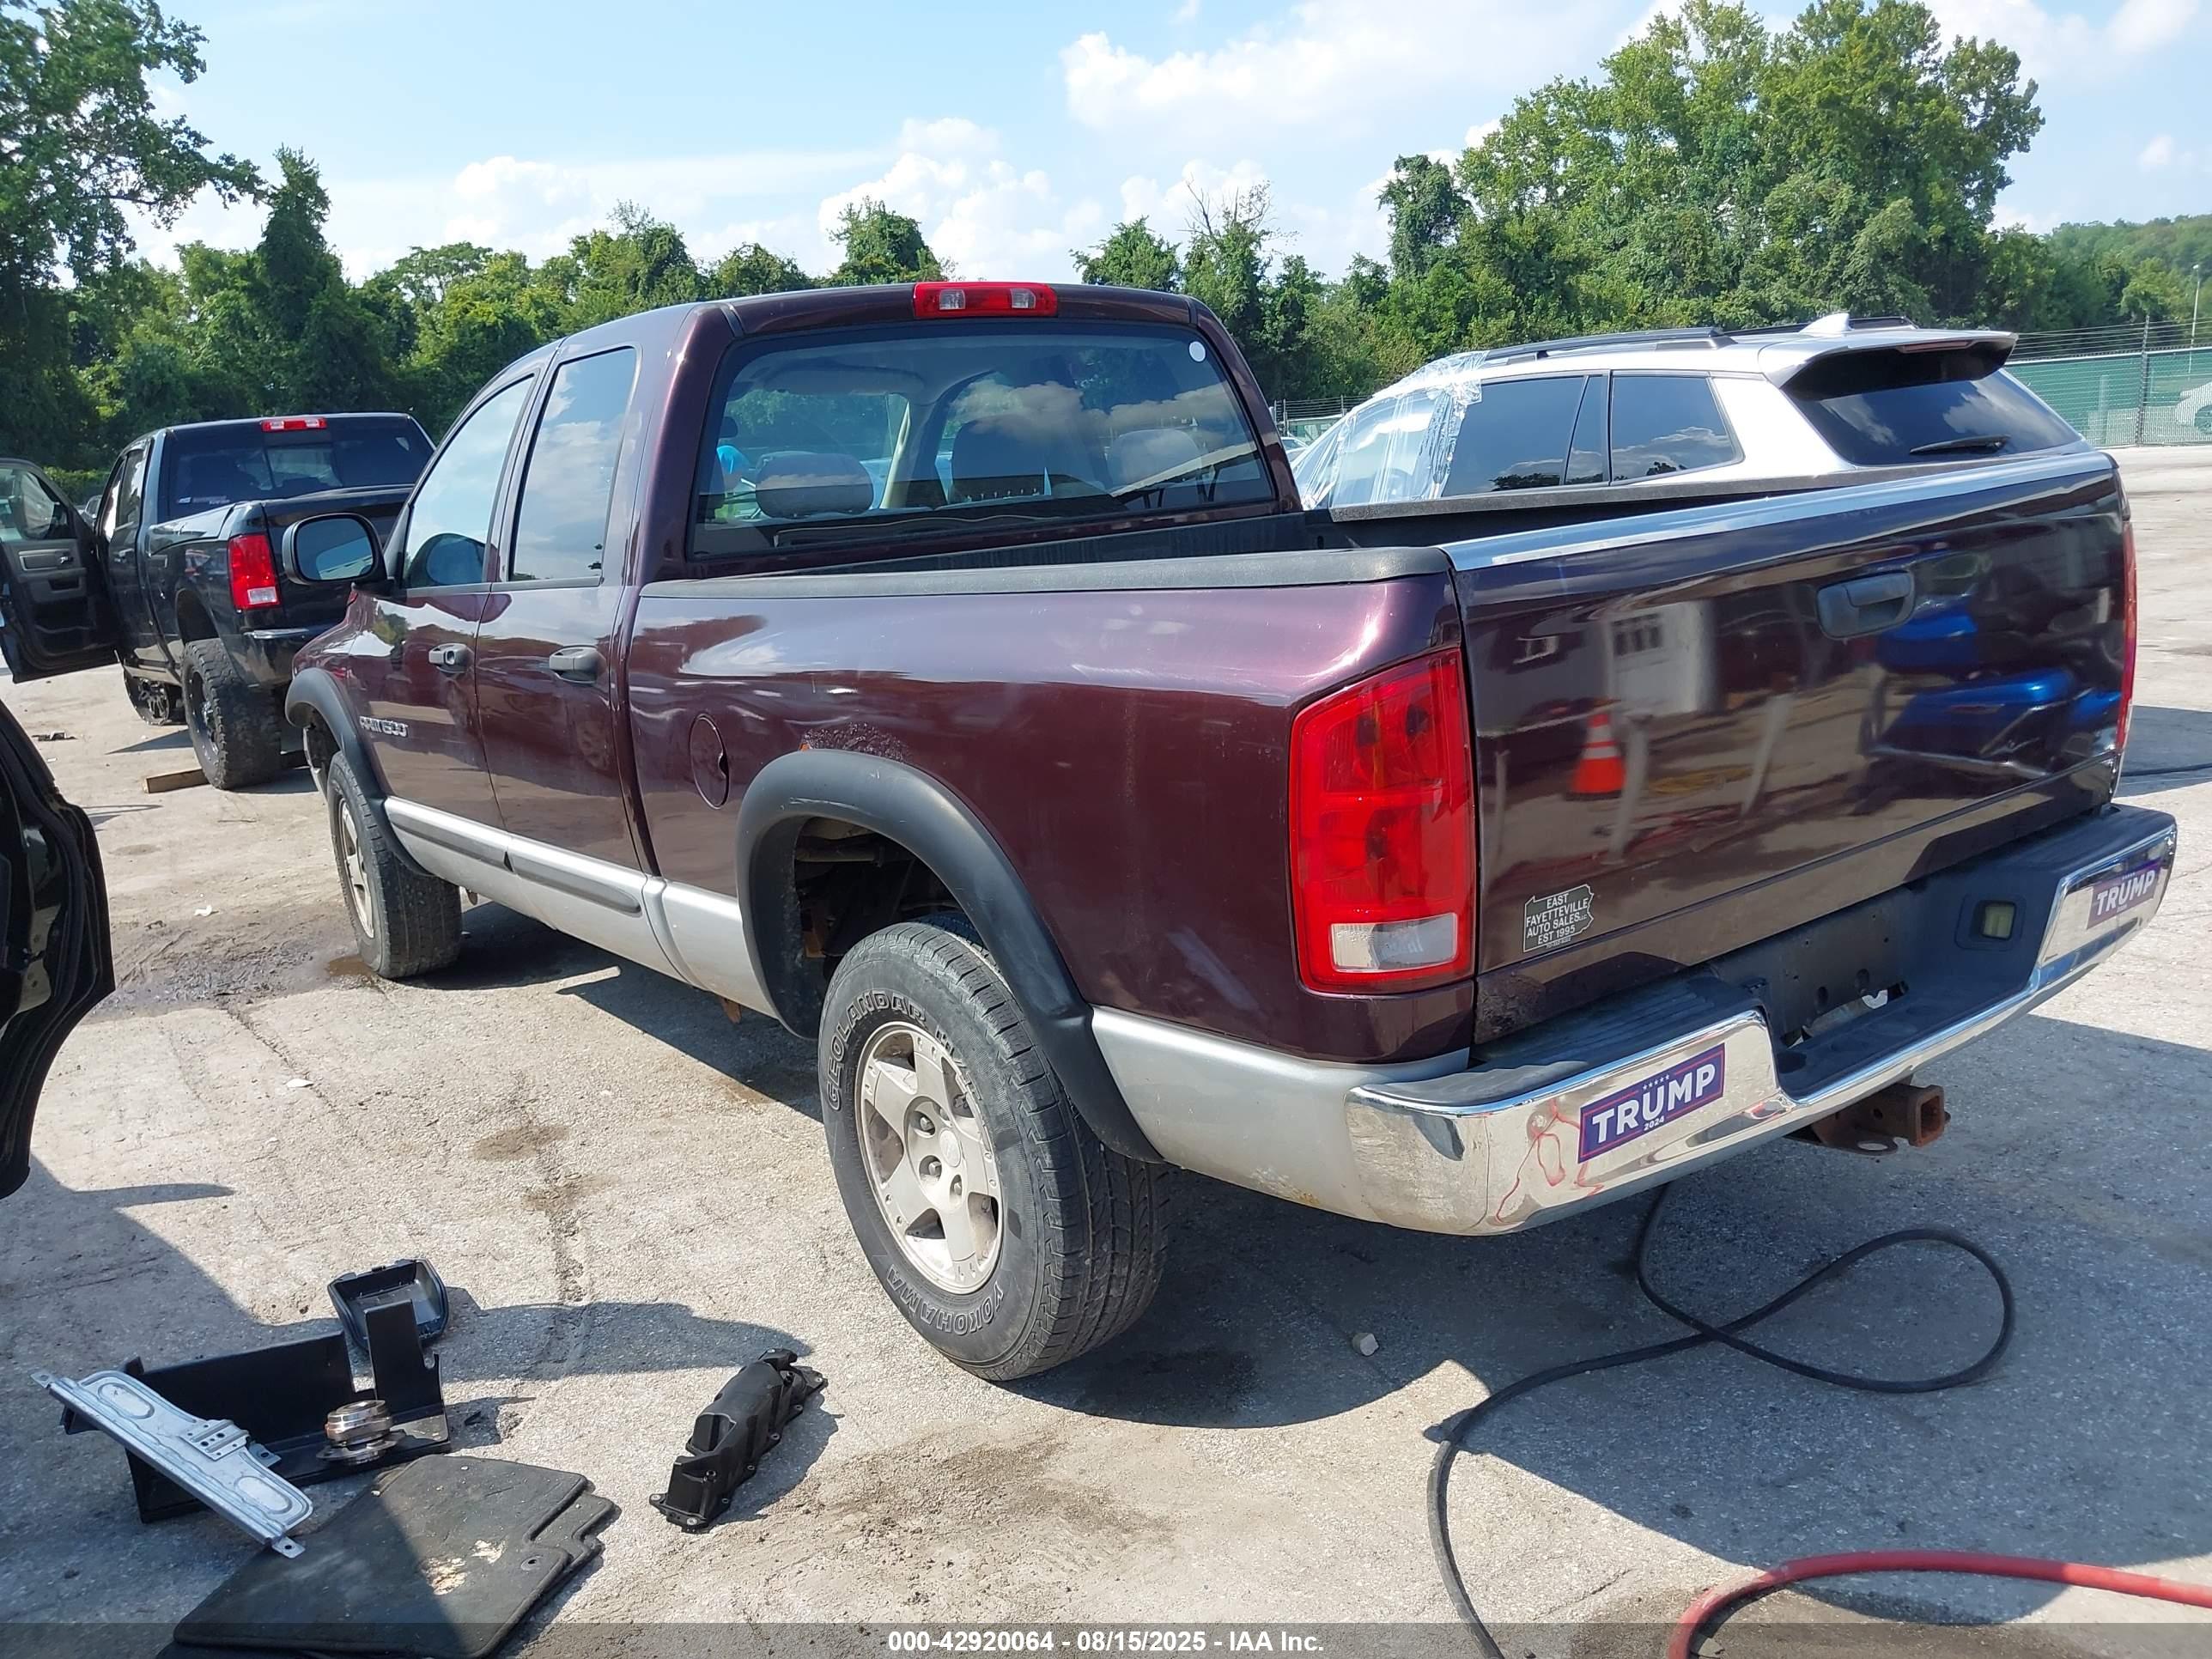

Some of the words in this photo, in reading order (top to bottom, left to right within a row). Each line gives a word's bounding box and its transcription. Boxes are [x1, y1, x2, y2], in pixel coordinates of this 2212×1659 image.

[1547, 893, 1569, 909] EAST
[2097, 870, 2155, 916] TRUMP
[1526, 897, 1589, 928] FAYETTEVILLE
[1526, 921, 1550, 939] AUTO
[1553, 912, 1580, 929] SALES
[1537, 931, 1554, 945] EST
[1556, 925, 1575, 939] 1995
[827, 991, 927, 1111] GEOLANDAR
[1592, 1063, 1716, 1144] TRUMP
[1644, 1116, 1664, 1132] 2024
[886, 1264, 1005, 1335] YOKOHAMA
